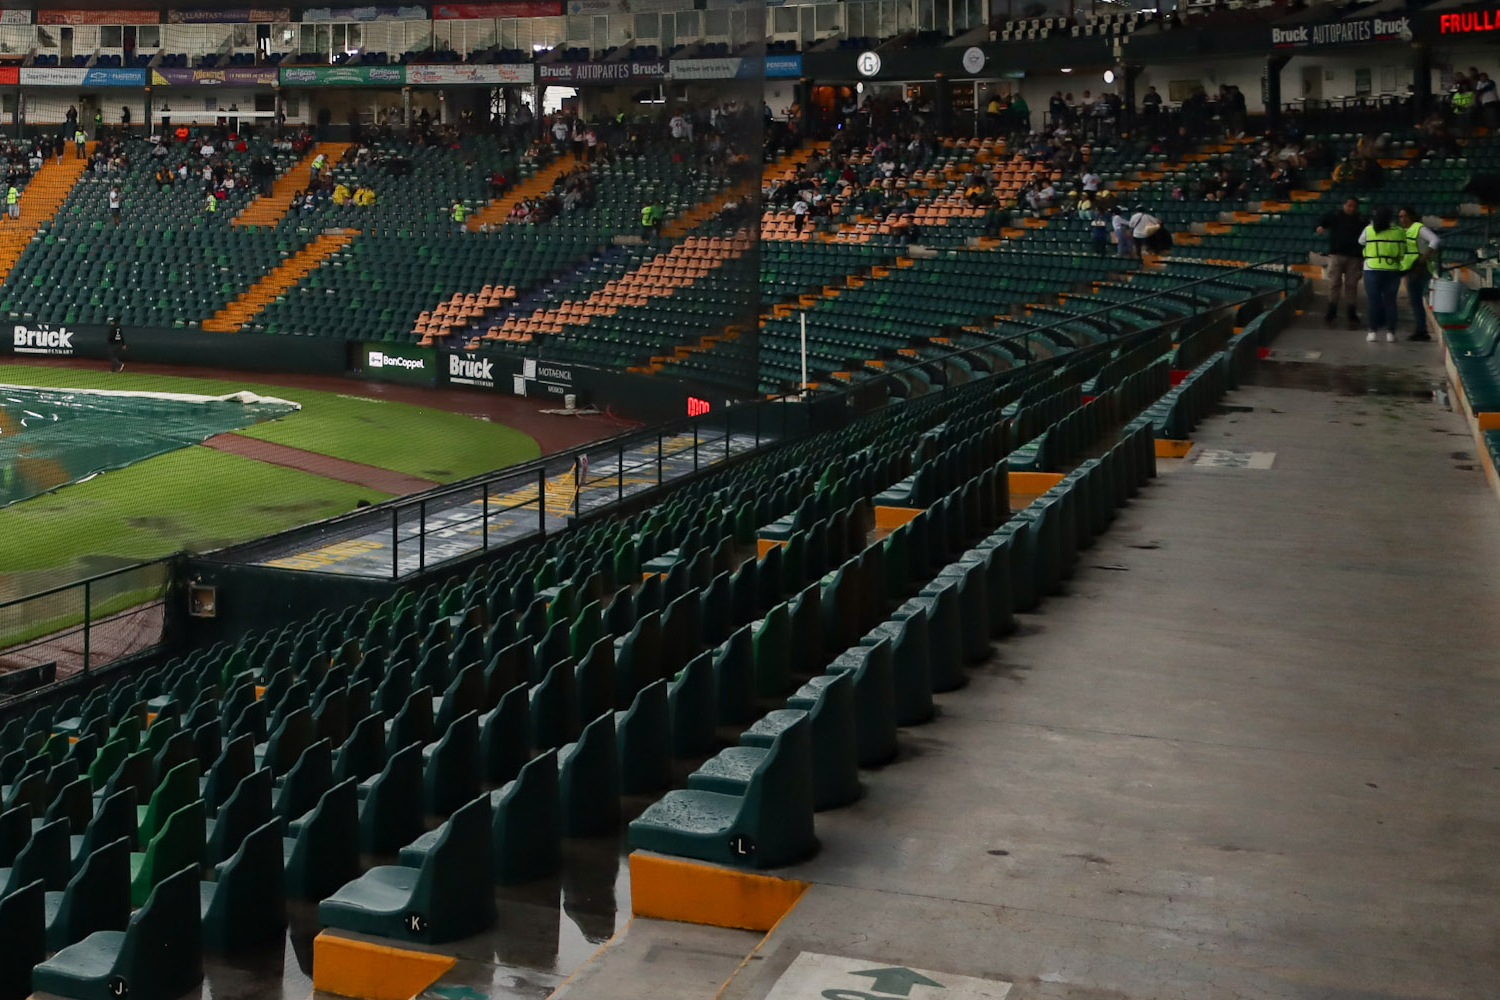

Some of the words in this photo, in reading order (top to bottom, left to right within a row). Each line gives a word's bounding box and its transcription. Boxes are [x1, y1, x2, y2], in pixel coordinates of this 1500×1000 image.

[1313, 21, 1371, 44] AUTOPARTES
[576, 64, 629, 79] AUTOPARTES
[864, 57, 874, 72] G
[14, 325, 73, 347] Brück
[383, 355, 425, 370] BanCoppel
[449, 353, 494, 379] Brück
[738, 838, 747, 854] L
[411, 915, 420, 931] K
[115, 982, 123, 995] J
